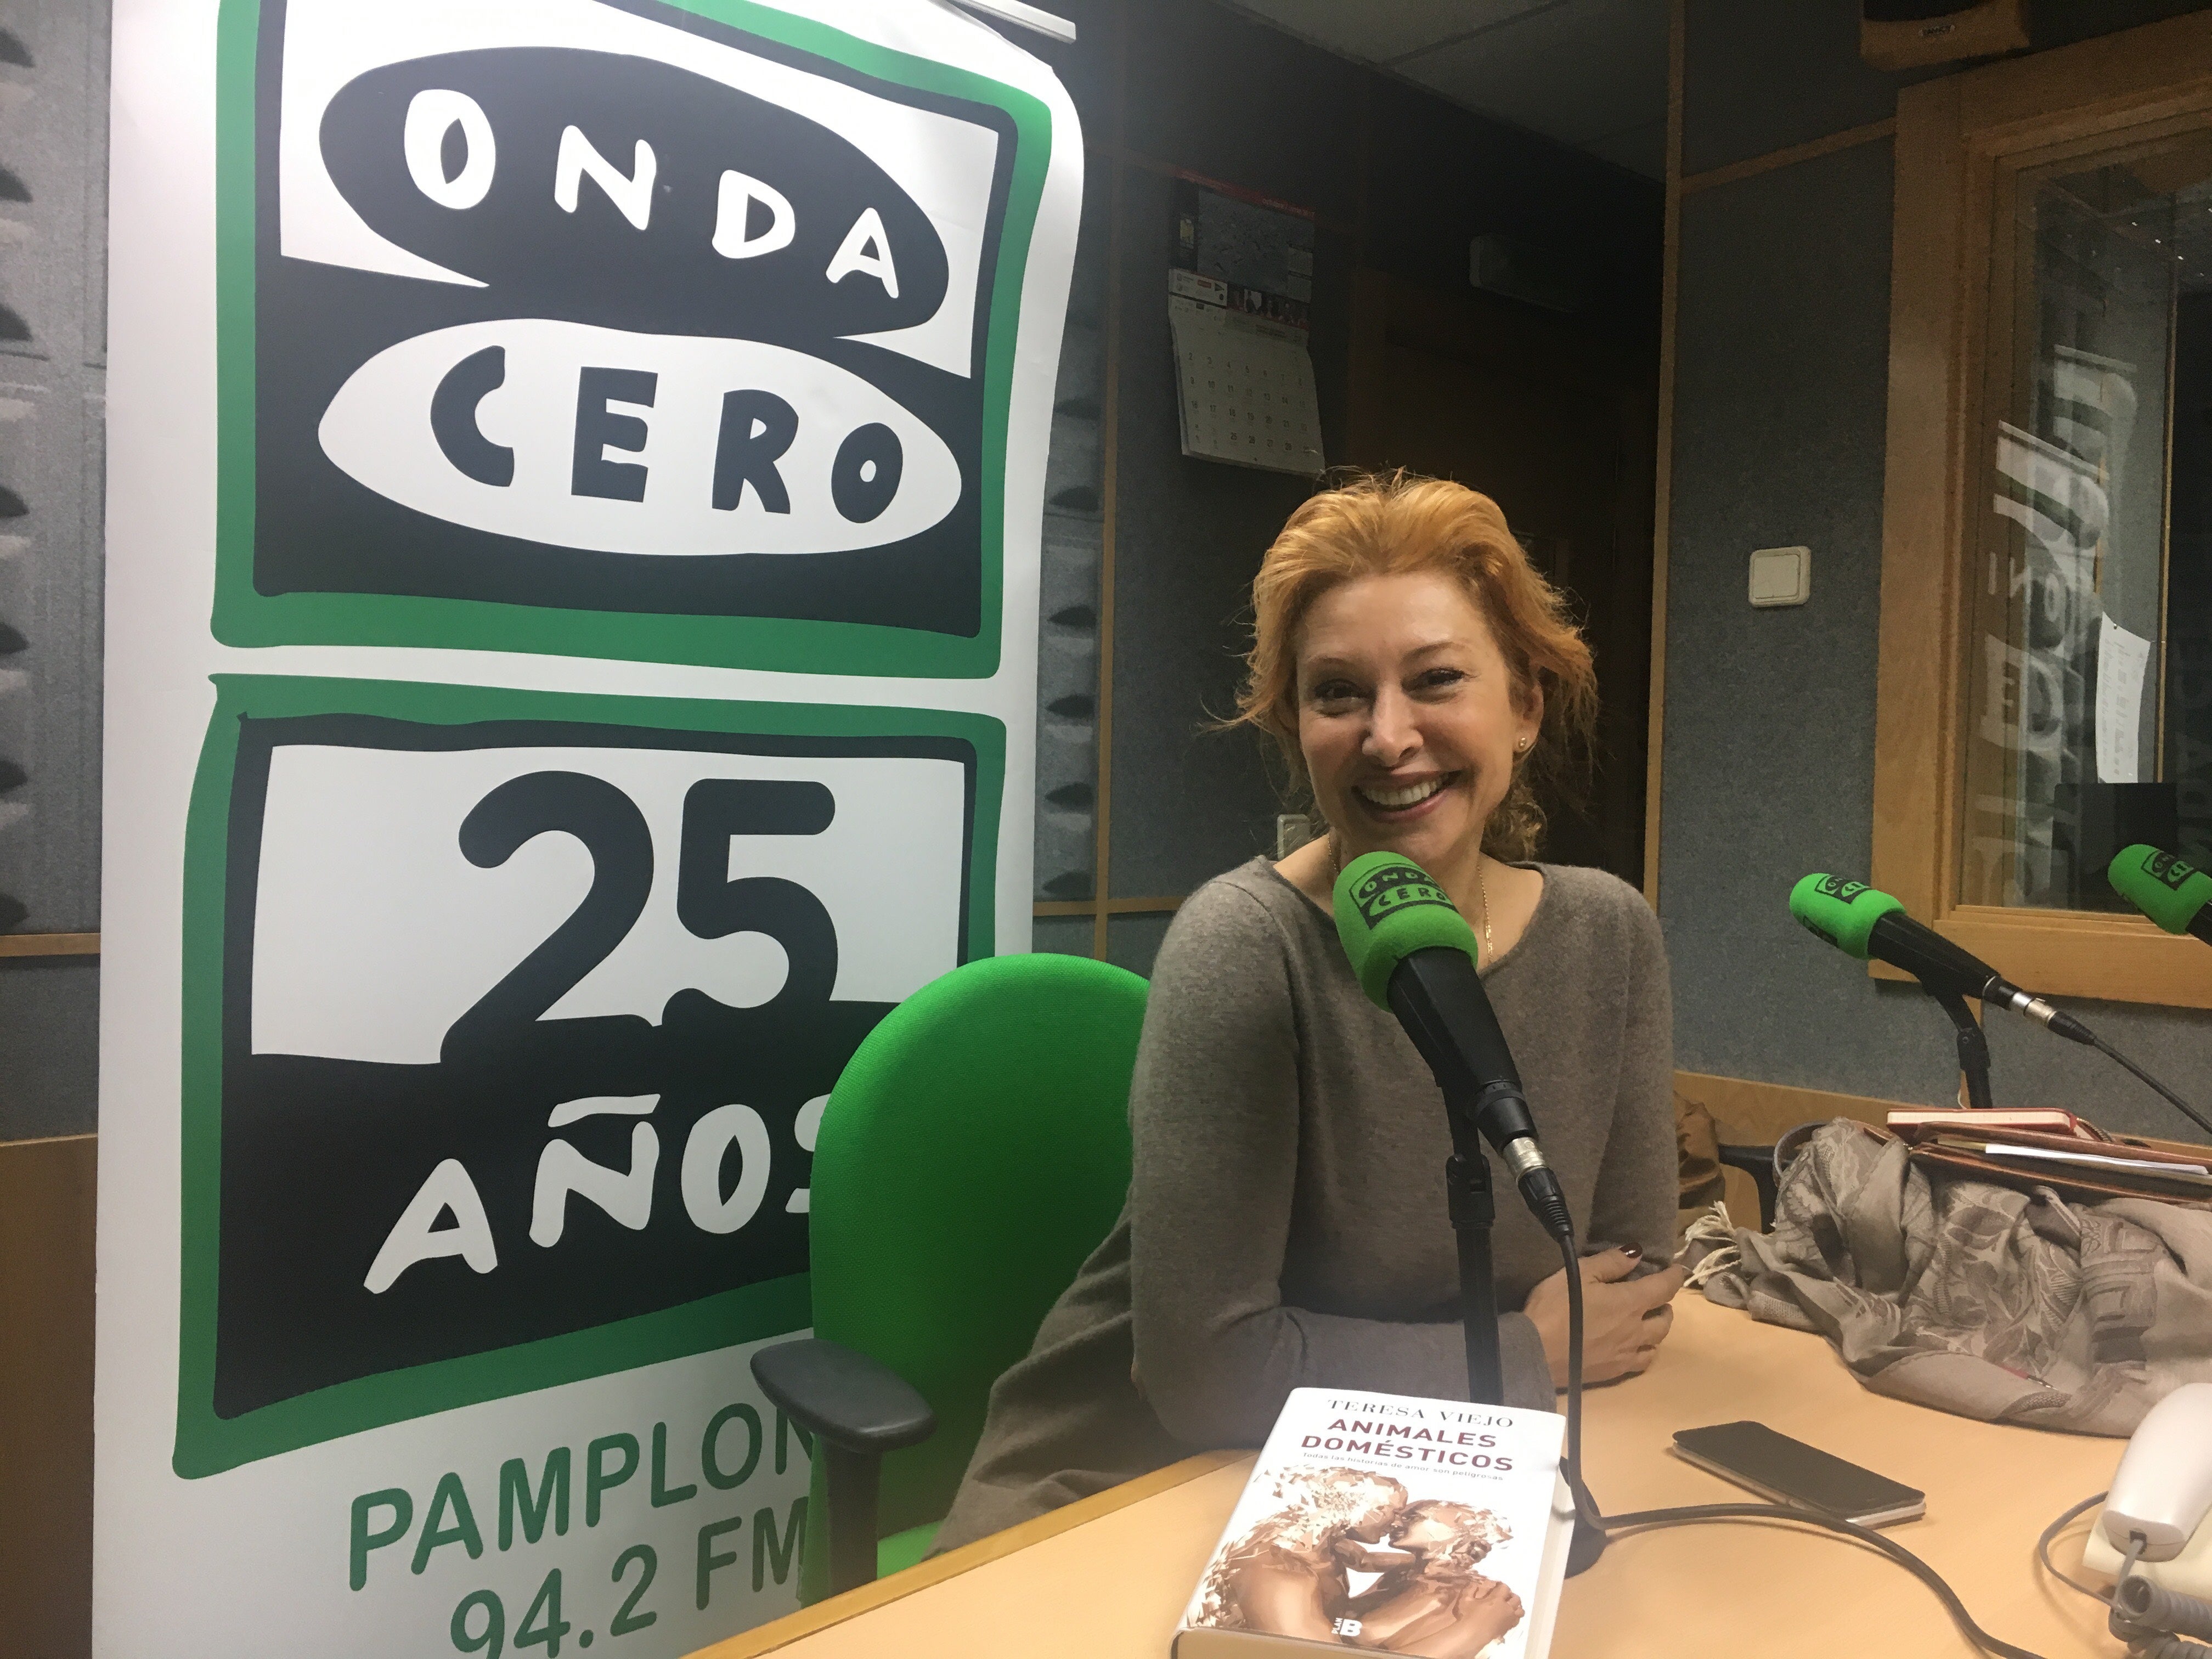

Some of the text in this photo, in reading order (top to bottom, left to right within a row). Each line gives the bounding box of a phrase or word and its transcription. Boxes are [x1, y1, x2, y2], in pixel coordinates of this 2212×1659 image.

[404, 89, 899, 298] ONDA
[430, 345, 903, 523] CERO
[1378, 887, 1446, 906] CERO
[440, 770, 838, 1064] 25
[1328, 1400, 1514, 1427] TERESA VIEJO
[1327, 1418, 1497, 1448] ANIMALES
[1301, 1435, 1514, 1471] DOMÉSTICOS
[1347, 1457, 1389, 1466] historias
[1452, 1470, 1504, 1480] peligrosas
[450, 1496, 809, 1659] 94.2 FM
[1339, 1618, 1363, 1637] B
